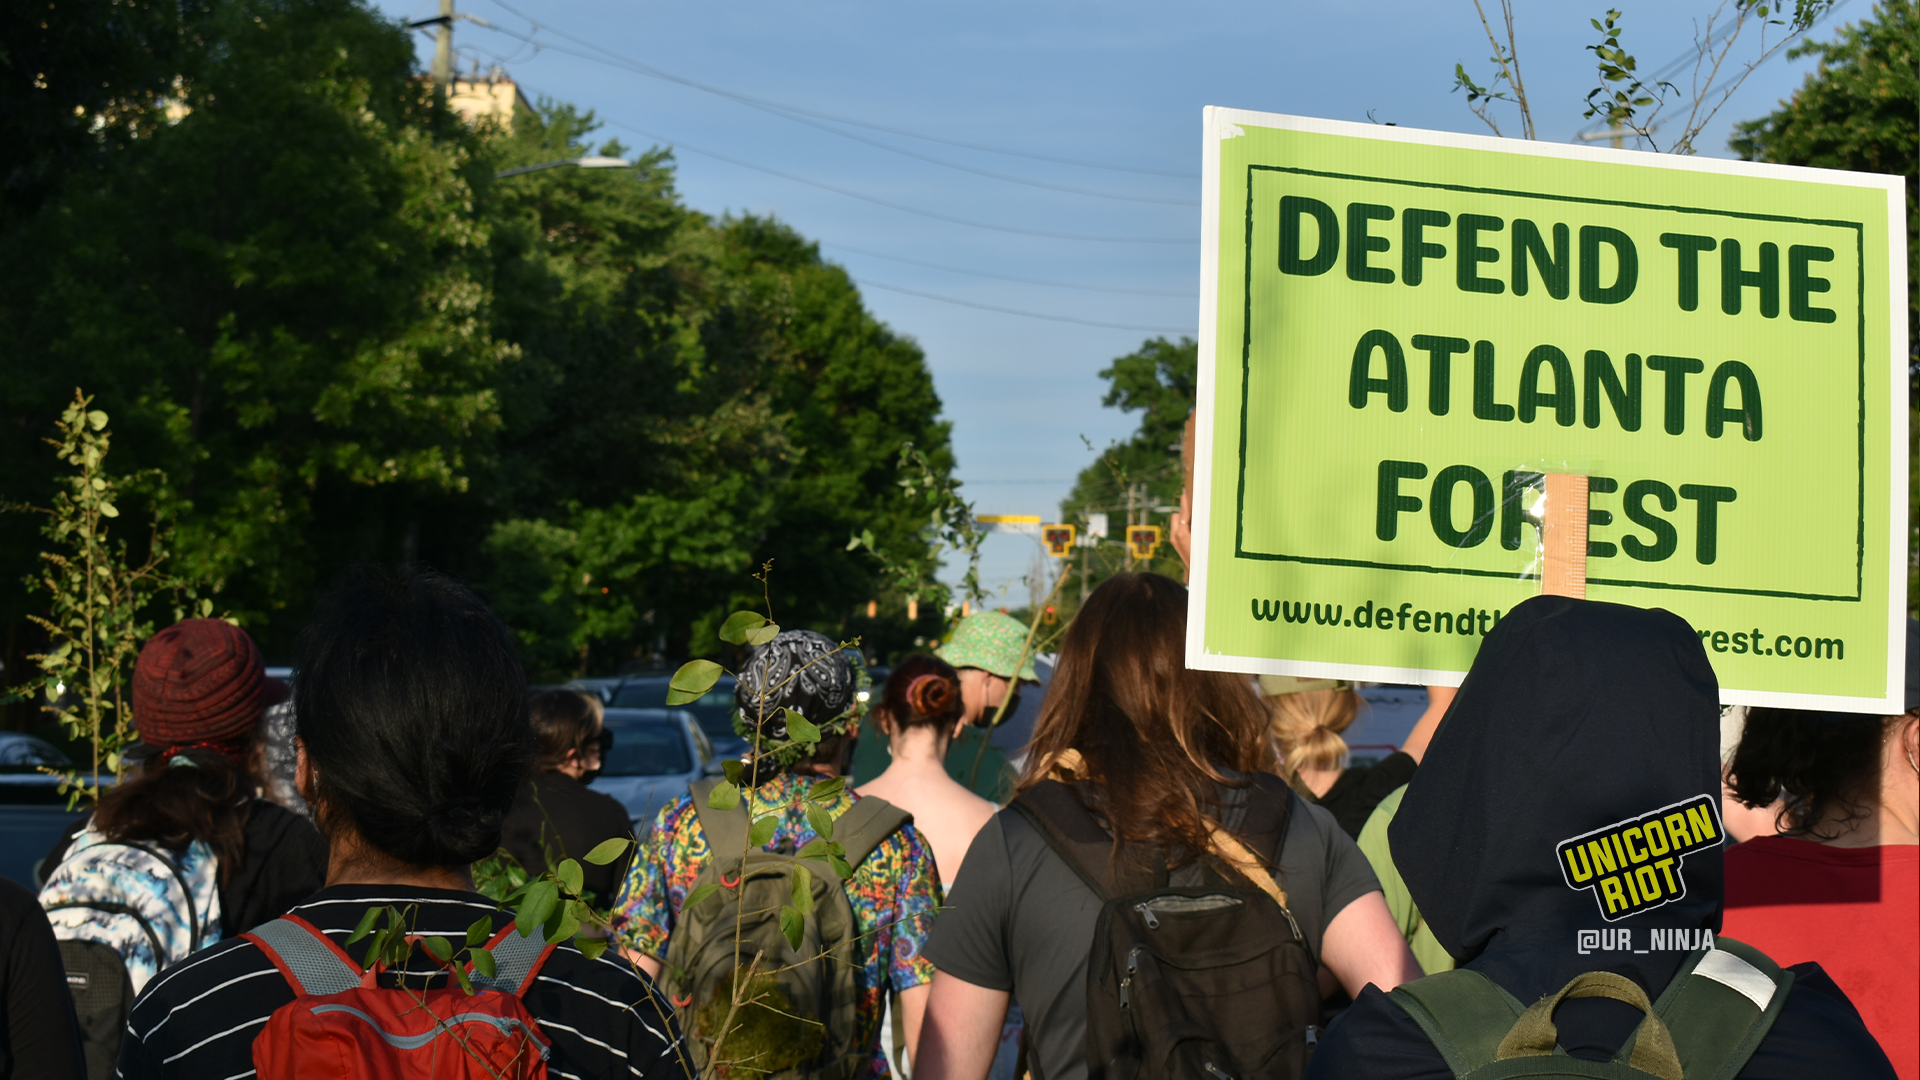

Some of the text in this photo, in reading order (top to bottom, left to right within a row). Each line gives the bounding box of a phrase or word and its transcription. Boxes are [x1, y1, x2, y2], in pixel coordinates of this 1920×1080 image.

[1276, 194, 1838, 325] DEFEND THE
[1348, 329, 1763, 442] ATLANTA
[1375, 459, 1737, 565] FOREST
